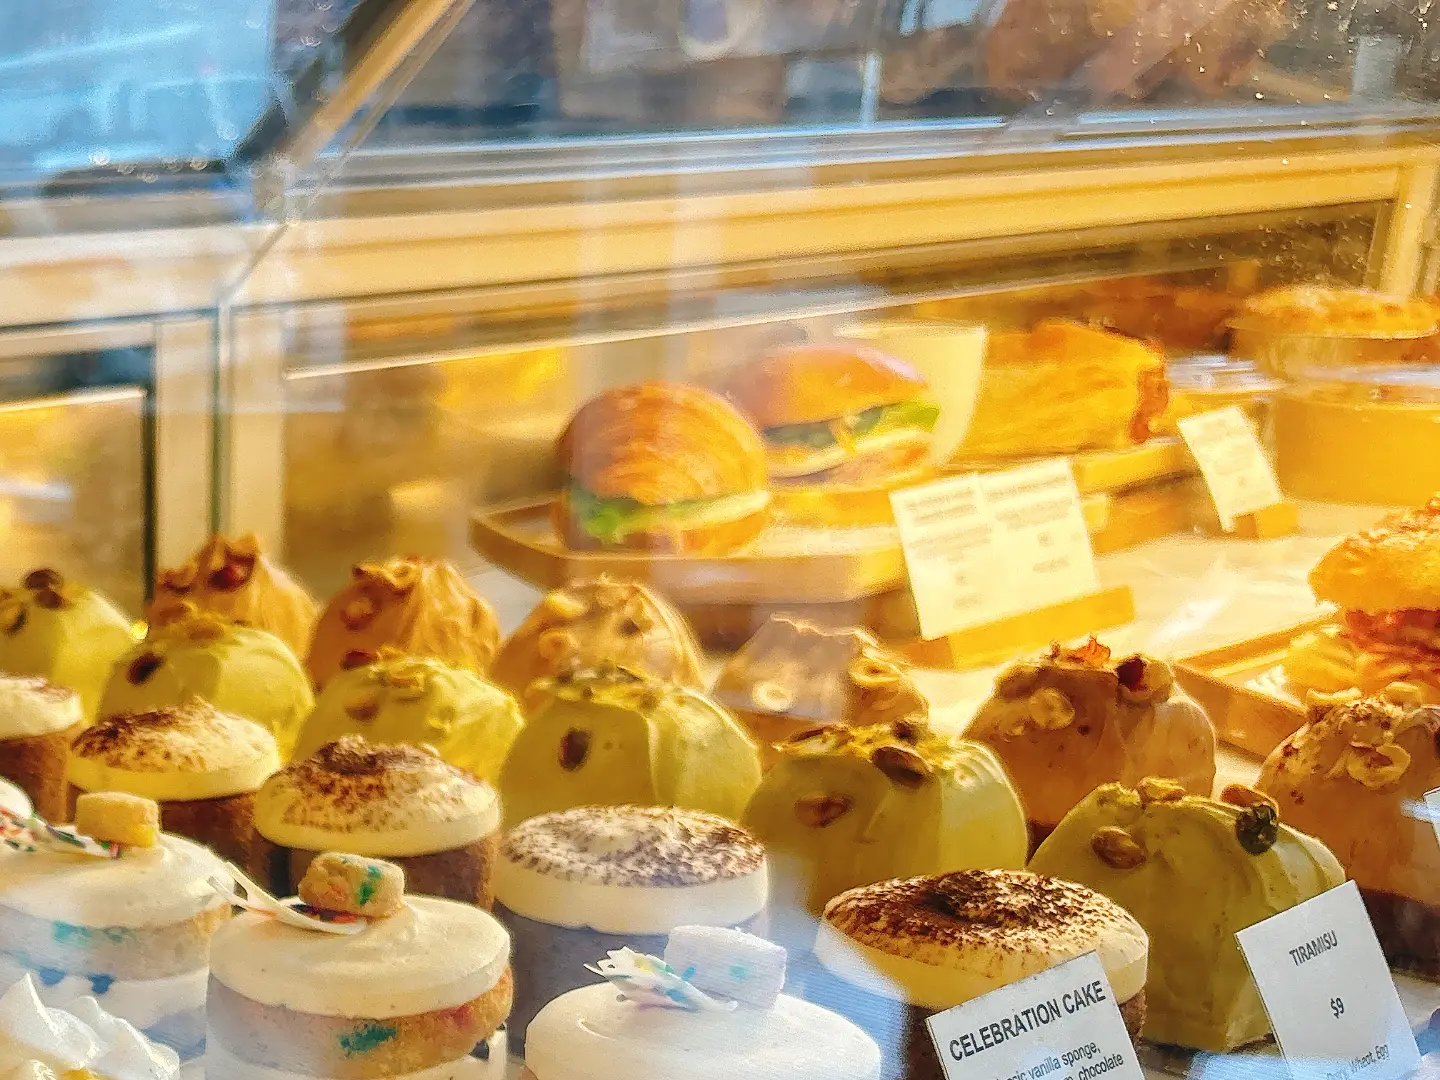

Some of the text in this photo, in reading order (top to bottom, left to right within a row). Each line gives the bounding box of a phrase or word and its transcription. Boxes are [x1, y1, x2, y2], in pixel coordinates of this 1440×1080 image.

[1289, 930, 1338, 967] TIRAMISU
[949, 980, 1107, 1061] CELEBRATION CAKE
[1330, 997, 1344, 1019] $9
[1027, 1056, 1061, 1080] vanilla
[1061, 1040, 1101, 1068] sponge,
